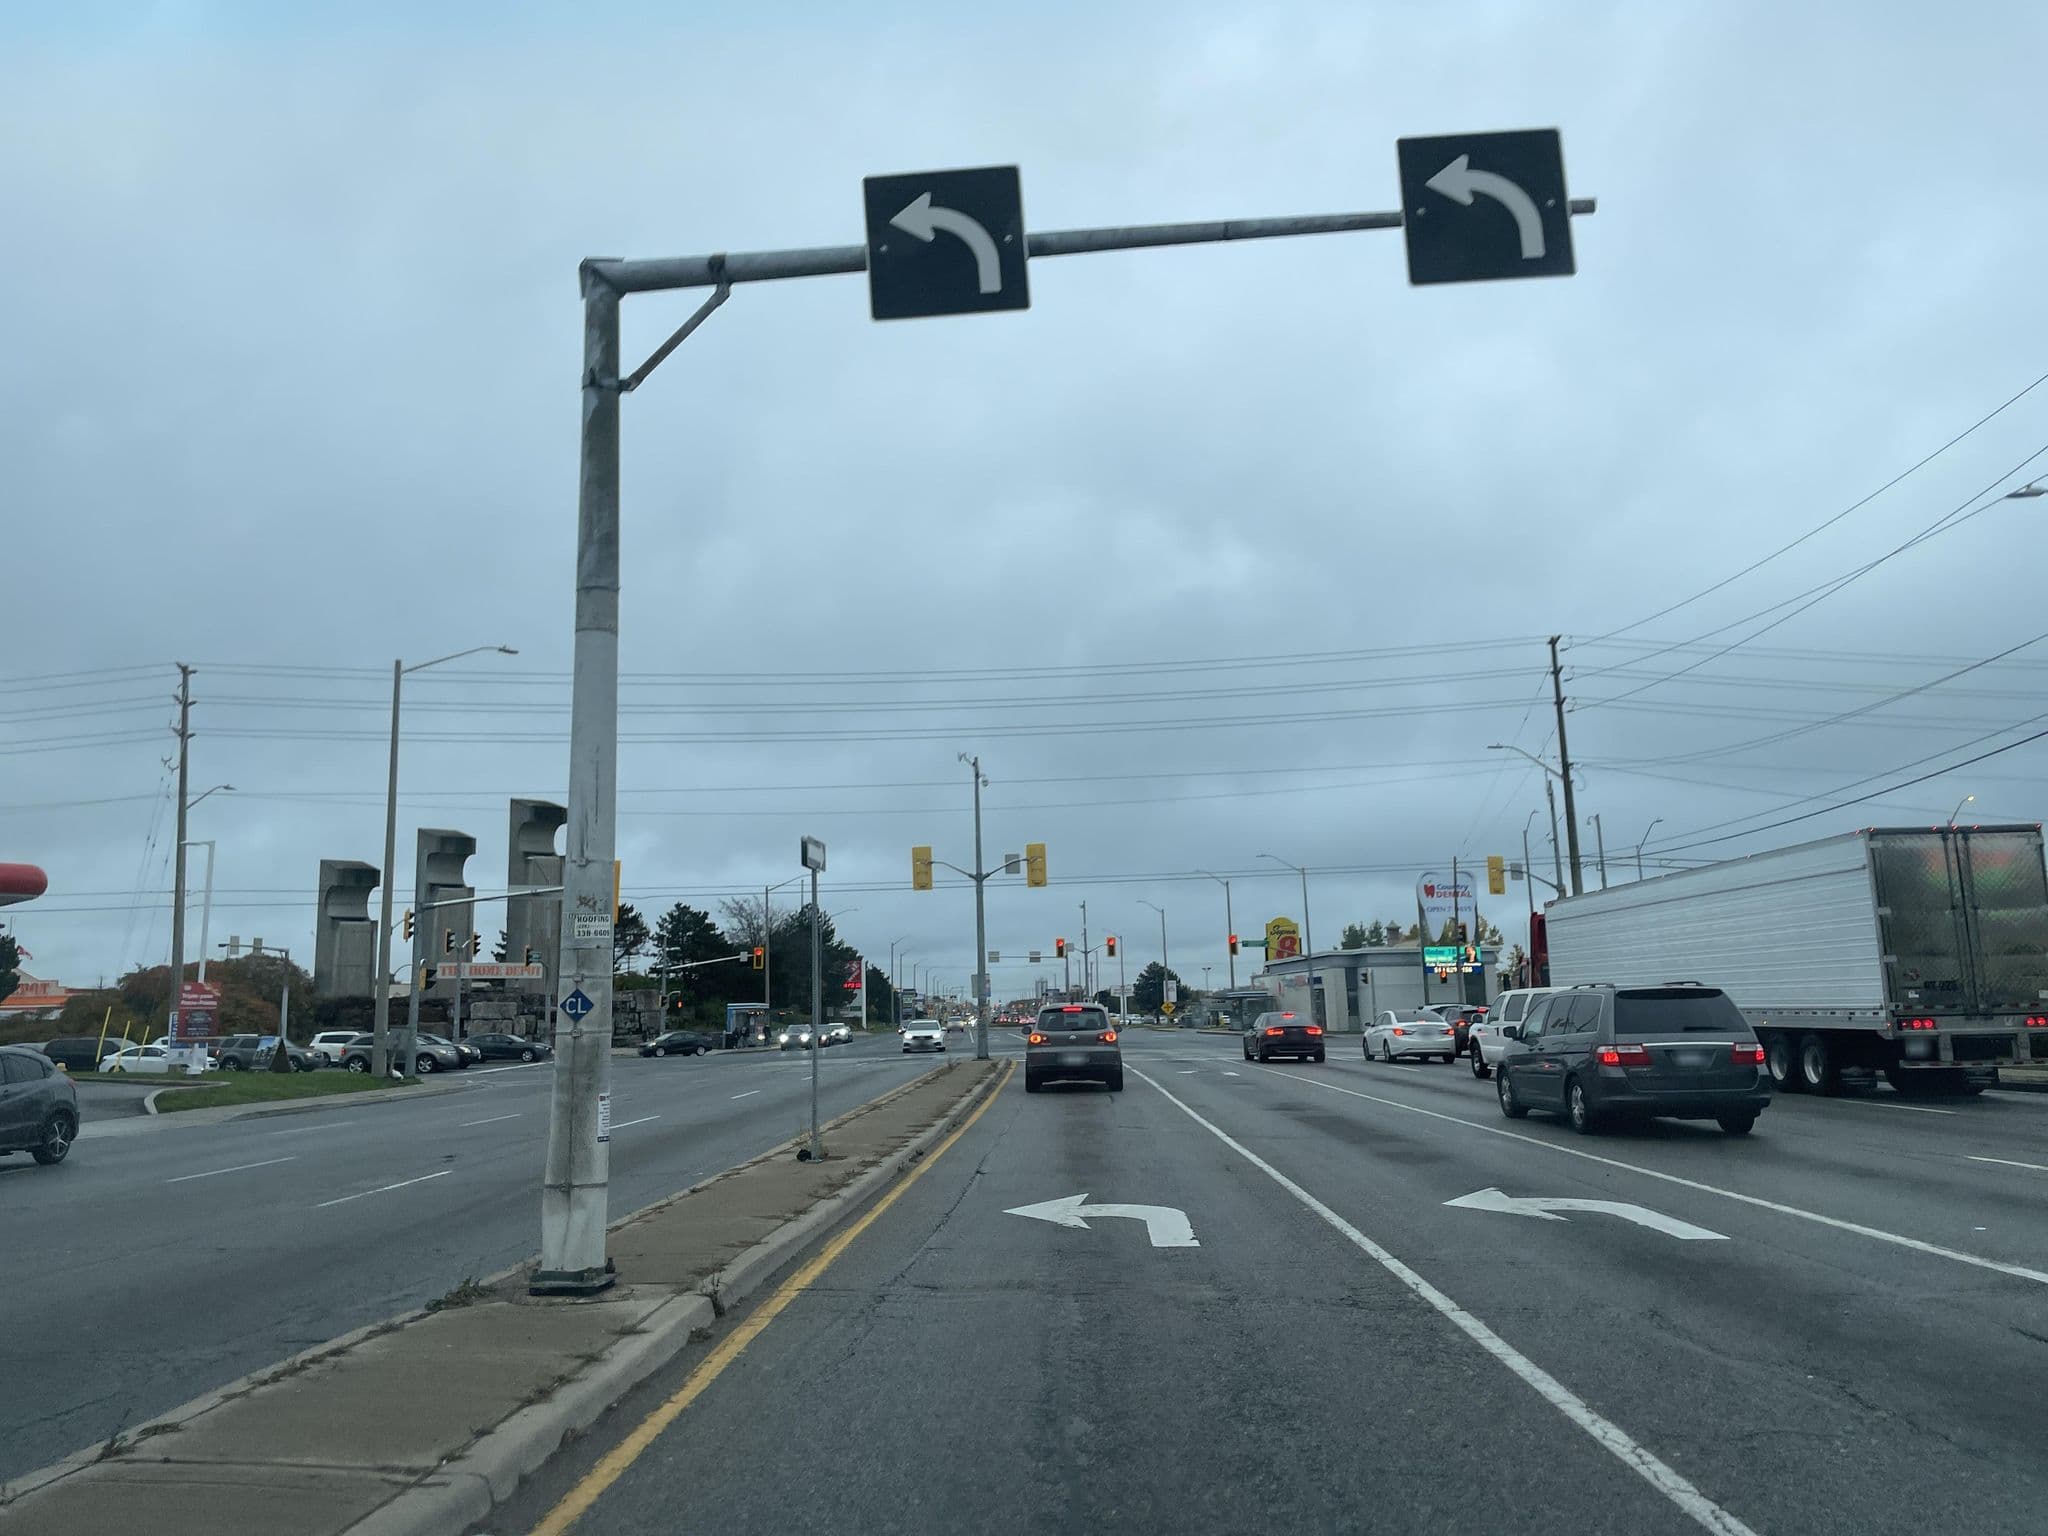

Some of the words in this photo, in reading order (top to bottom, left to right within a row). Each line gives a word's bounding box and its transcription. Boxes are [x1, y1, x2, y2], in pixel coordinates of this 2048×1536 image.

[1275, 936, 1298, 960] 8
[440, 965, 463, 976] TH
[469, 965, 500, 976] HOME
[505, 965, 540, 976] DEPOT
[566, 997, 587, 1014] CL
